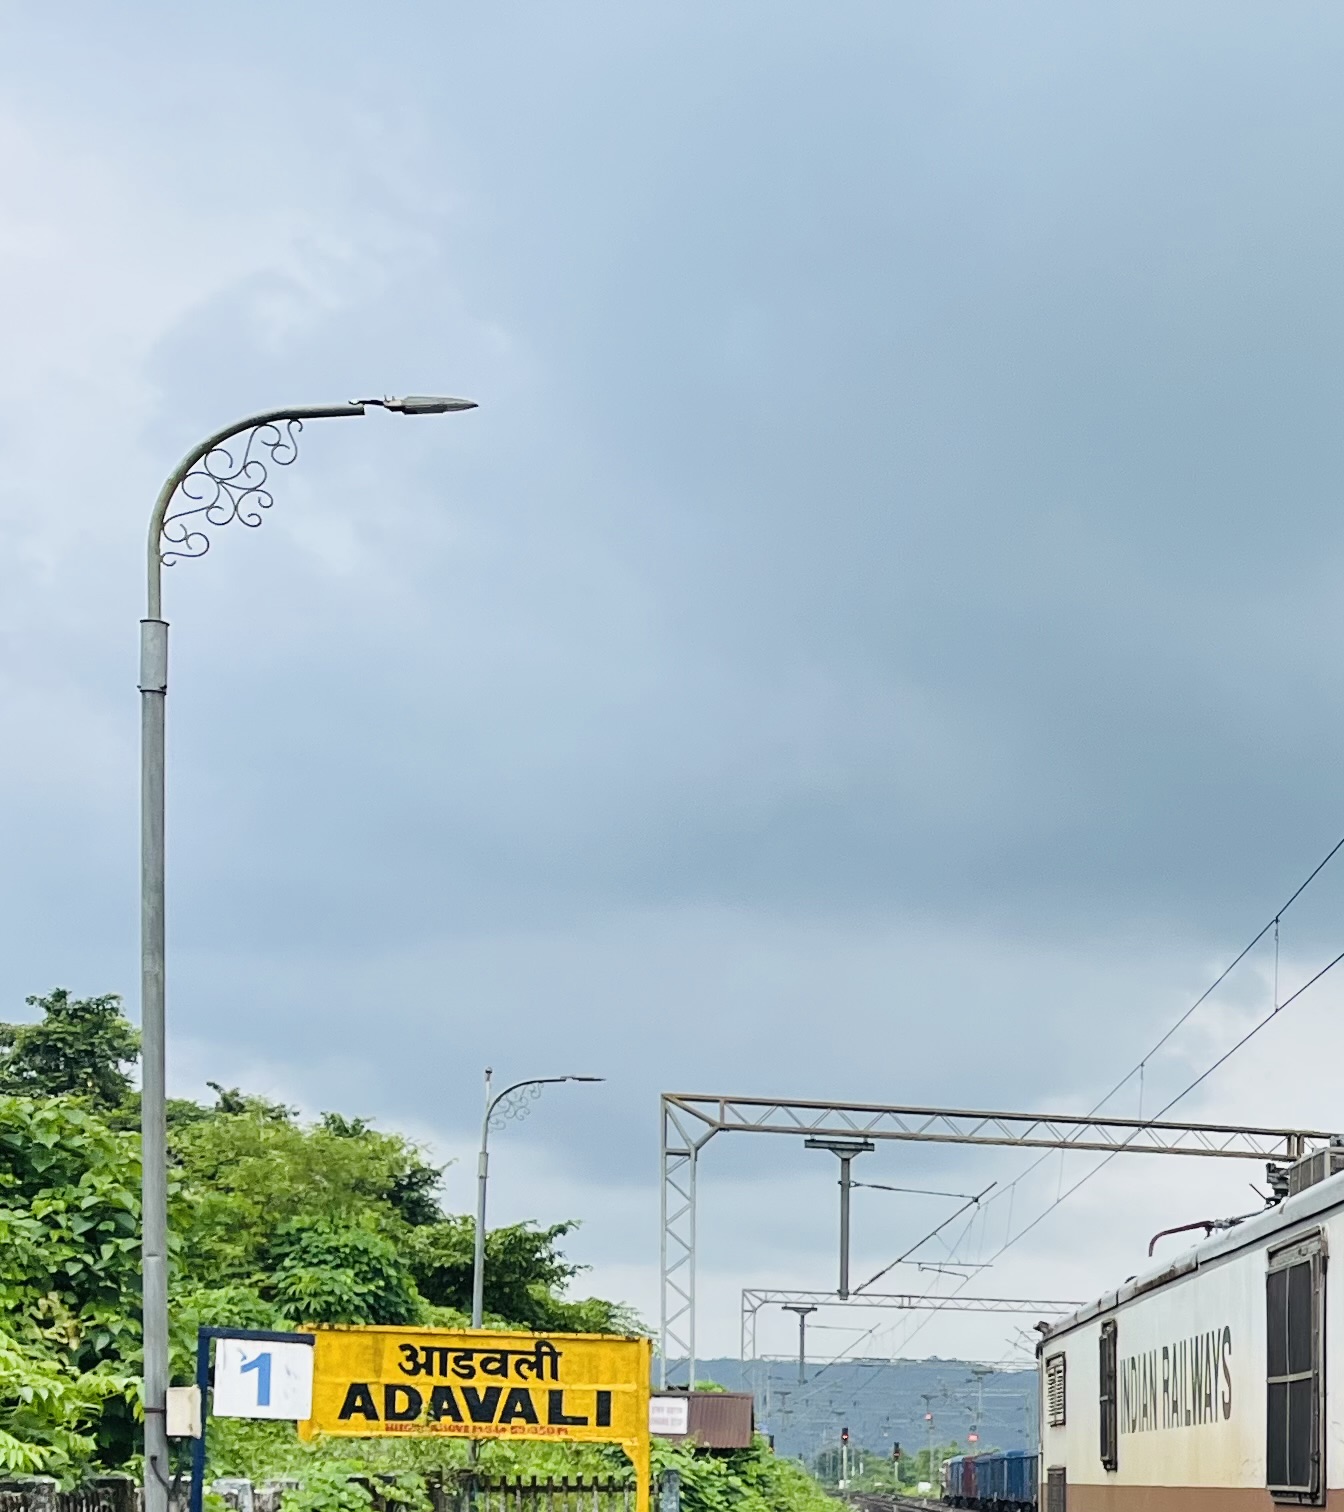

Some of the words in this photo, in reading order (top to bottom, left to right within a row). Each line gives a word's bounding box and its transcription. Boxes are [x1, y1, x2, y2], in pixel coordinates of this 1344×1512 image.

[240, 1352, 273, 1407] 1
[397, 1339, 563, 1382] आडवली
[1119, 1348, 1158, 1434] INDIAN
[1162, 1325, 1232, 1430] RAILWAYS
[338, 1382, 613, 1428] ADAVALI
